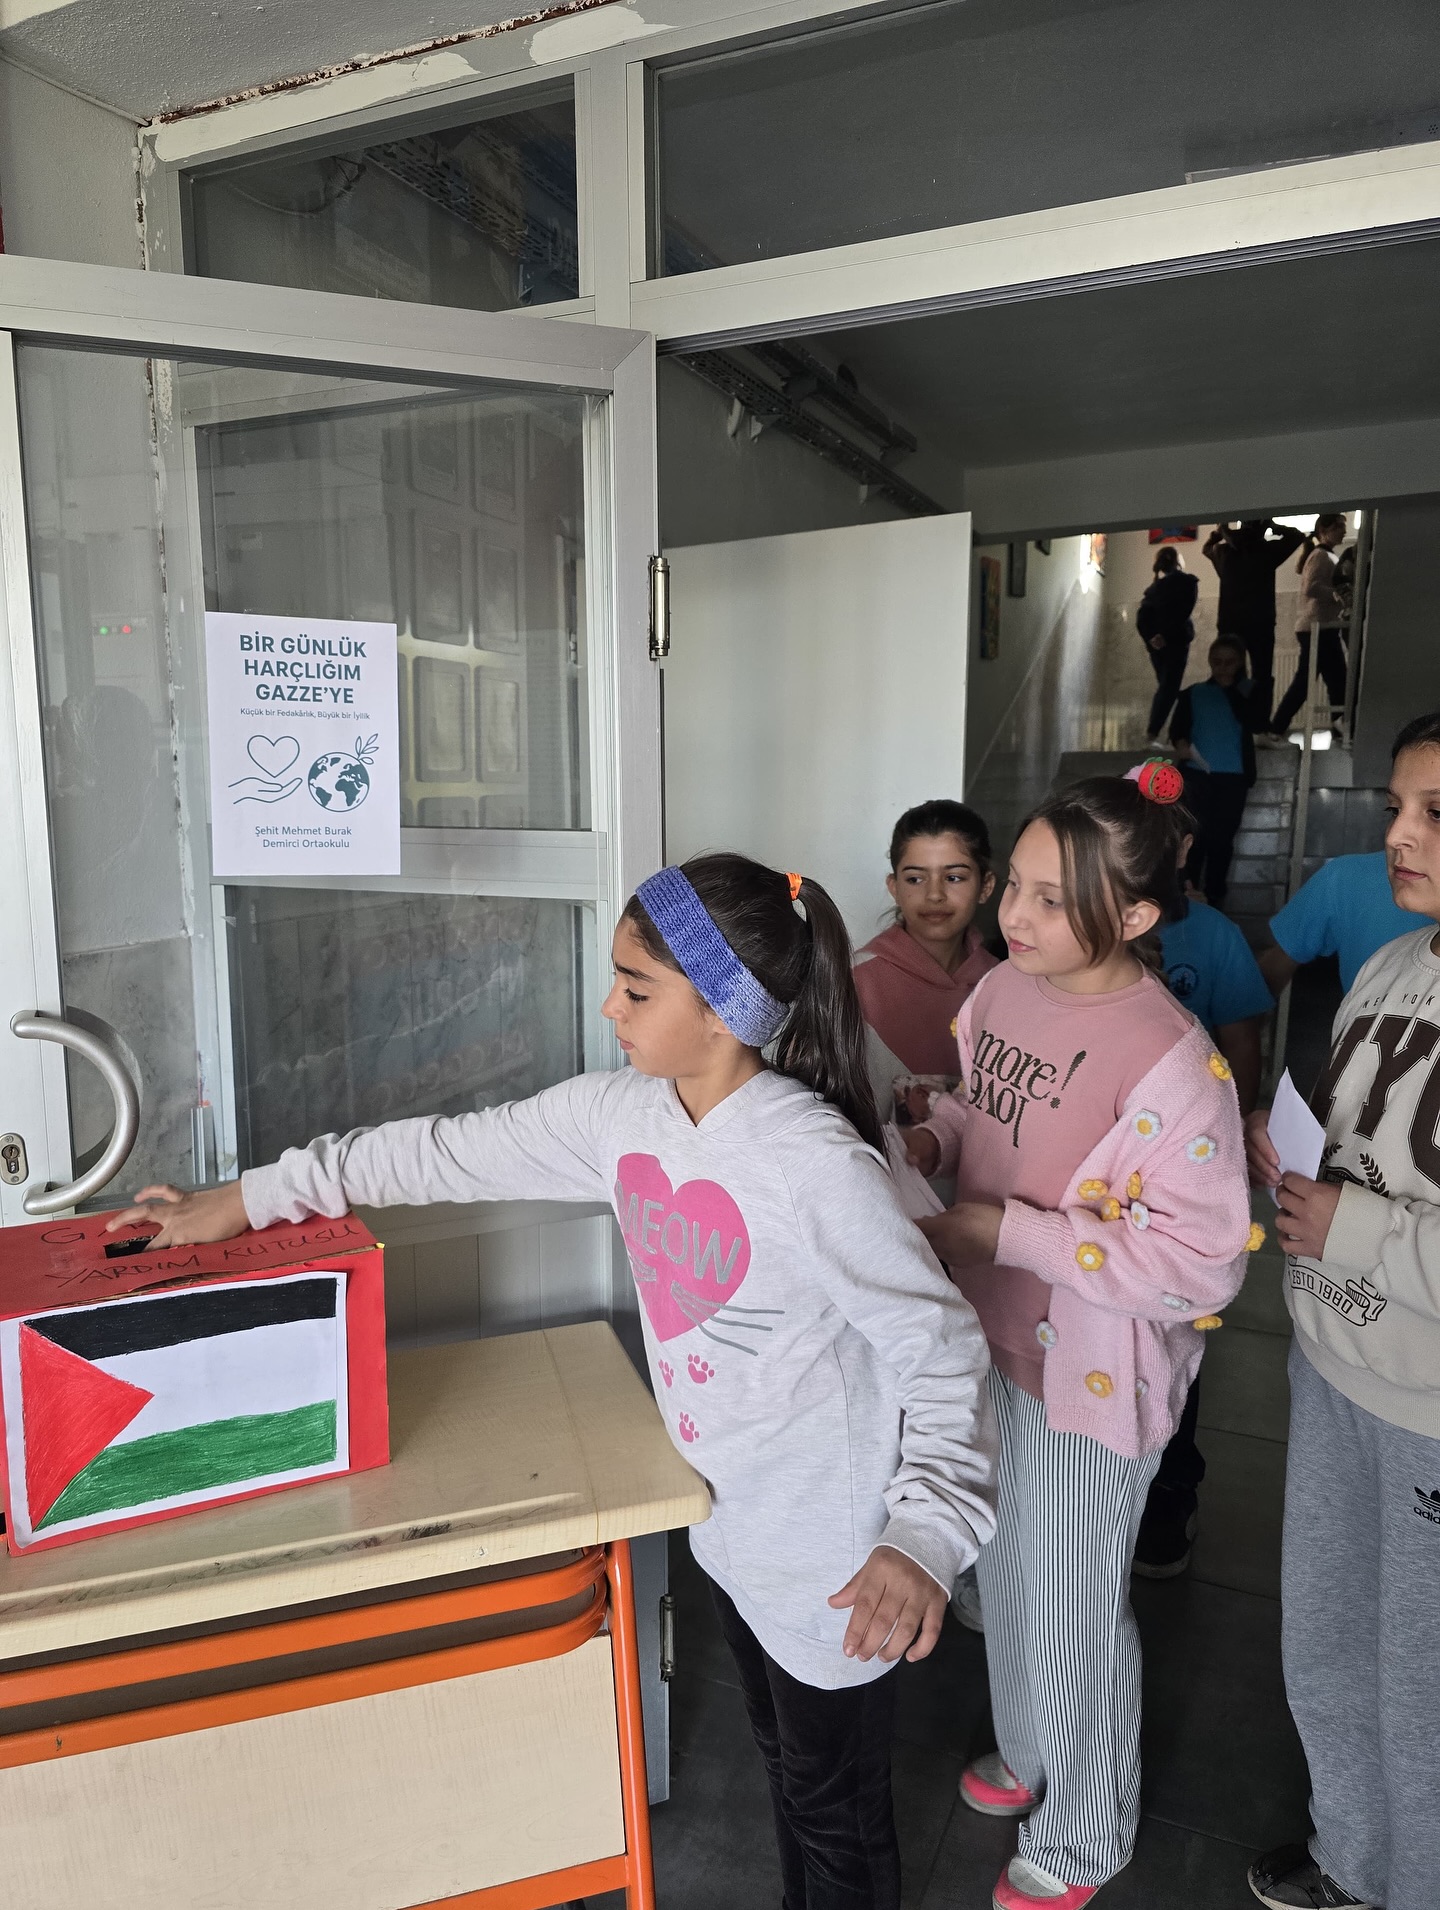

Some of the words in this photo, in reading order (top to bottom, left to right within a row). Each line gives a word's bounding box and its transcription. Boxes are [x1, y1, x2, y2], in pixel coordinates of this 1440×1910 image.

[239, 631, 275, 653] BİR
[281, 634, 367, 658] GÜNLÜK
[244, 658, 361, 682] HARÇLIĞIM
[240, 708, 264, 717] Küçük
[317, 711, 340, 720] Büyük
[341, 711, 351, 719] bir
[255, 826, 279, 837] Şehit
[281, 826, 322, 836] Mehmet
[325, 826, 352, 836] Burak
[262, 839, 300, 848] Demirci
[302, 839, 350, 848] Ortaokulu
[973, 1030, 1087, 1109] more!
[615, 1179, 743, 1284] MEOW
[44, 1254, 201, 1288] YARDIM
[223, 1223, 361, 1260] KUTUSU
[1319, 1280, 1353, 1314] 1980
